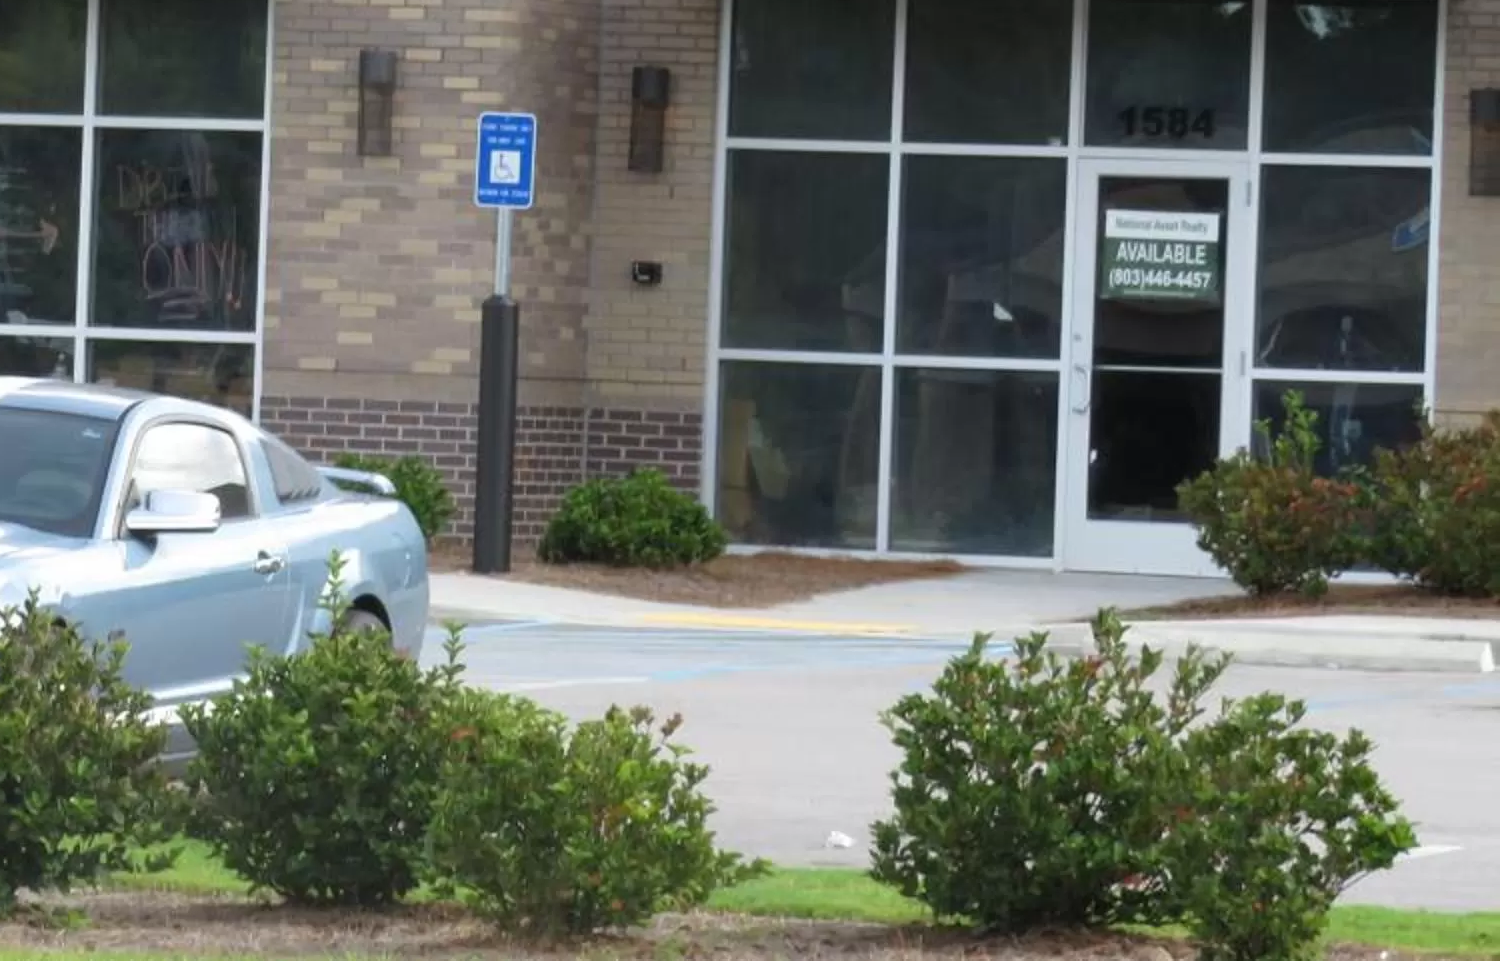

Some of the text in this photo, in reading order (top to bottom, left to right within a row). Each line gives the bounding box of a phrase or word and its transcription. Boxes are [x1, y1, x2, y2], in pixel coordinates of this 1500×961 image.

[1117, 104, 1217, 139] 1584
[1116, 241, 1207, 265] AVAILABLE
[1108, 268, 1213, 290] (803)446-4457
